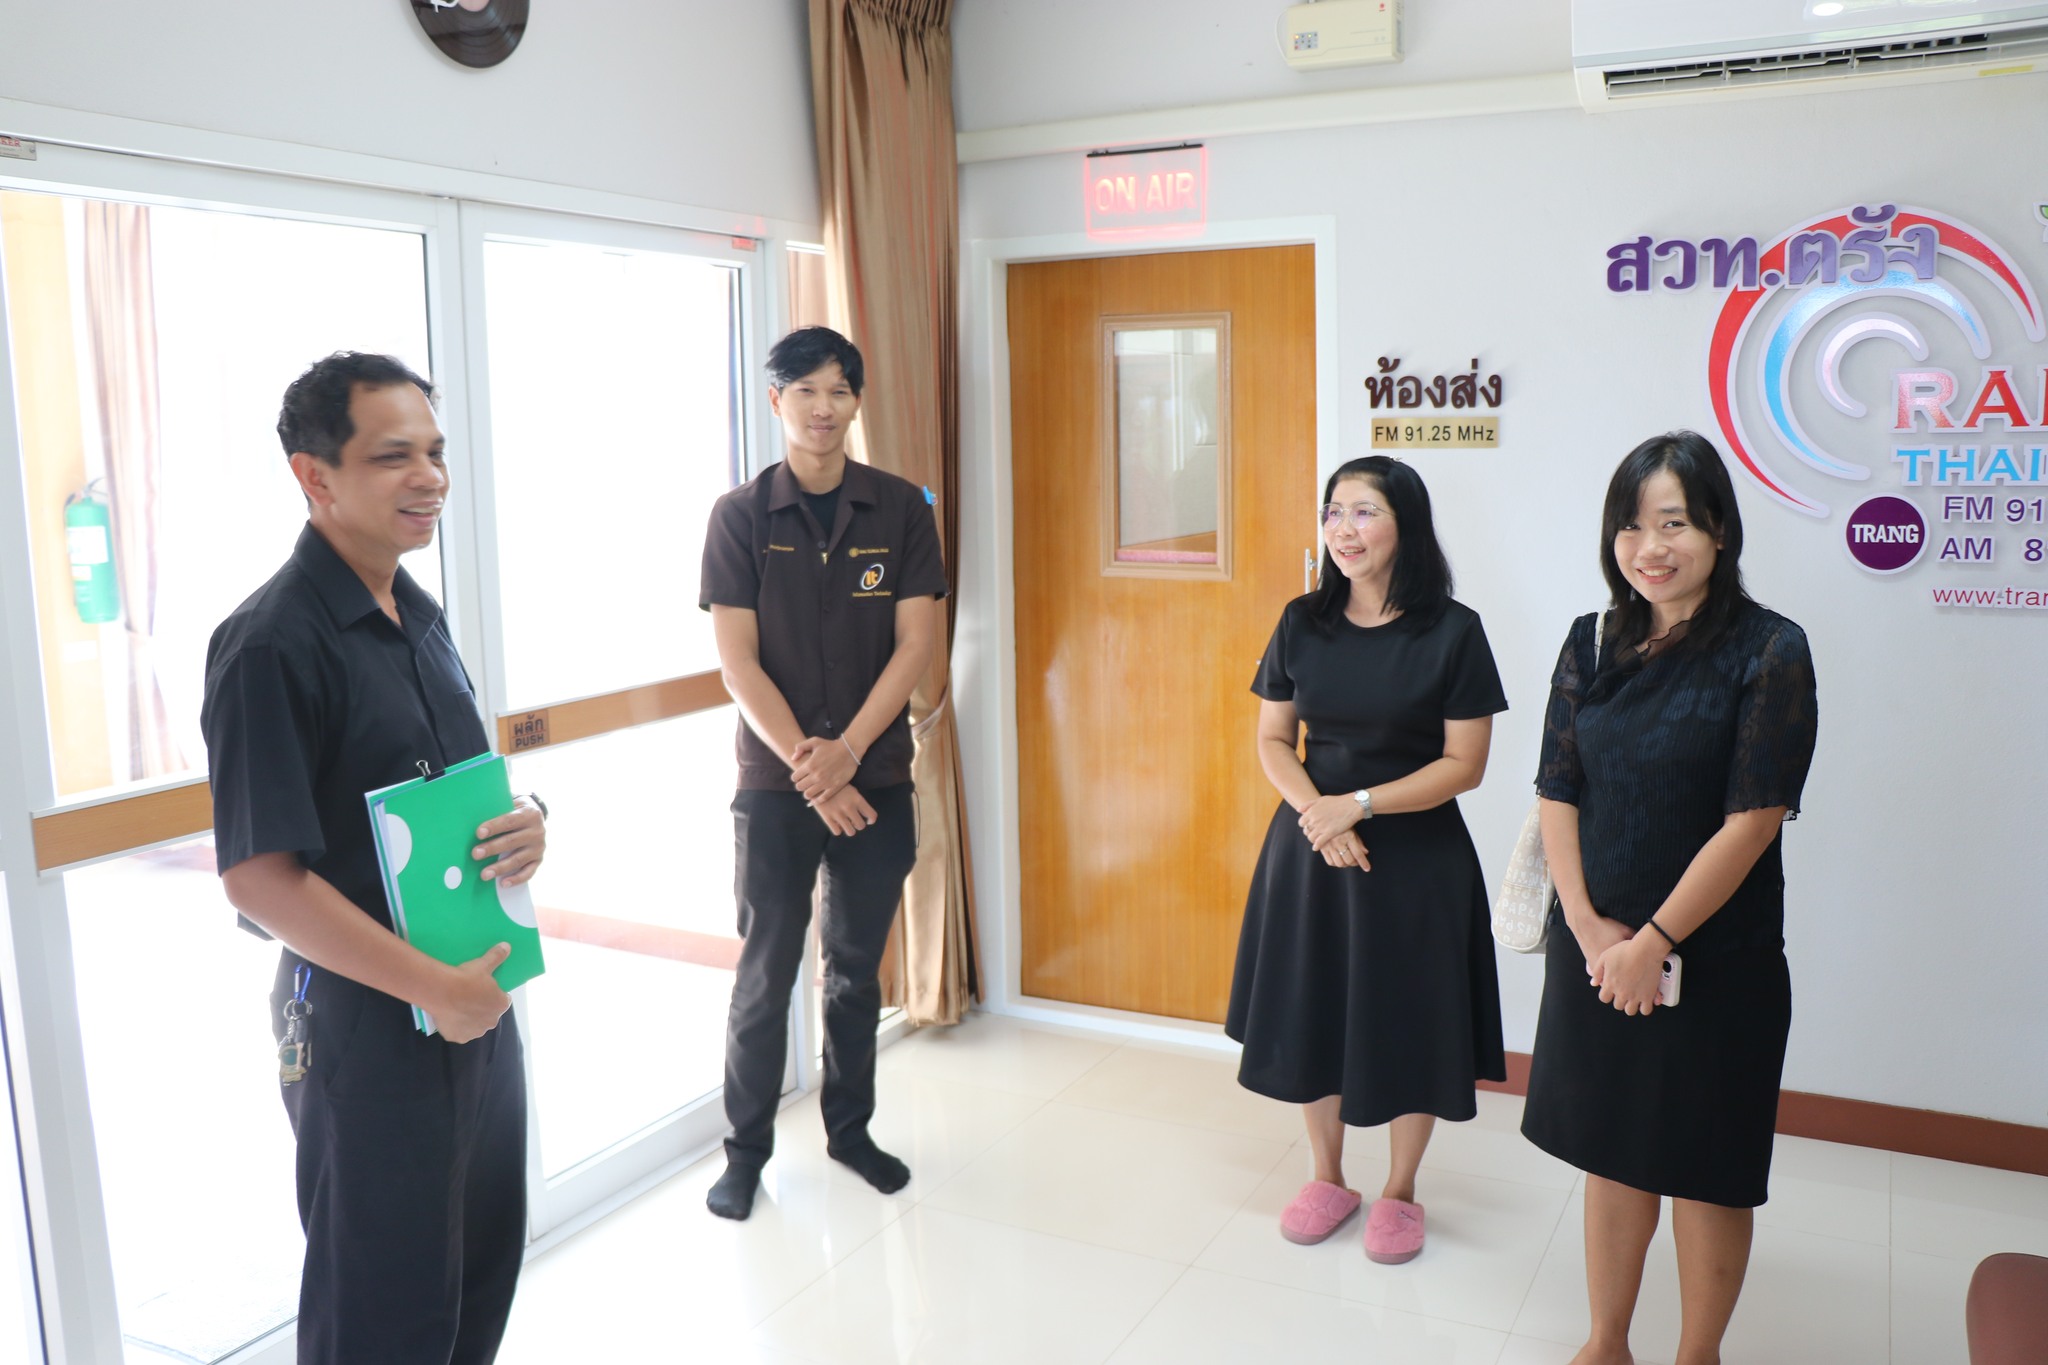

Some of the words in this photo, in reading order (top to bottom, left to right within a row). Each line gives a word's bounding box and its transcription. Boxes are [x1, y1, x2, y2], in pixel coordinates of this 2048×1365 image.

[1094, 176, 1137, 213] ON
[1146, 171, 1197, 211] AIR
[1606, 204, 1937, 292] สวท.ตรัง
[1364, 356, 1502, 409] ห้องส่ง
[1894, 368, 2048, 429] RA
[1375, 426, 1398, 442] FM
[1405, 425, 1451, 442] 91.25
[1458, 425, 1494, 441] MHz
[1944, 496, 1993, 520] FM
[1852, 523, 1919, 544] TRANG
[1940, 538, 1991, 560] AM
[513, 714, 544, 736] ผลัก
[515, 734, 544, 748] PUSH
